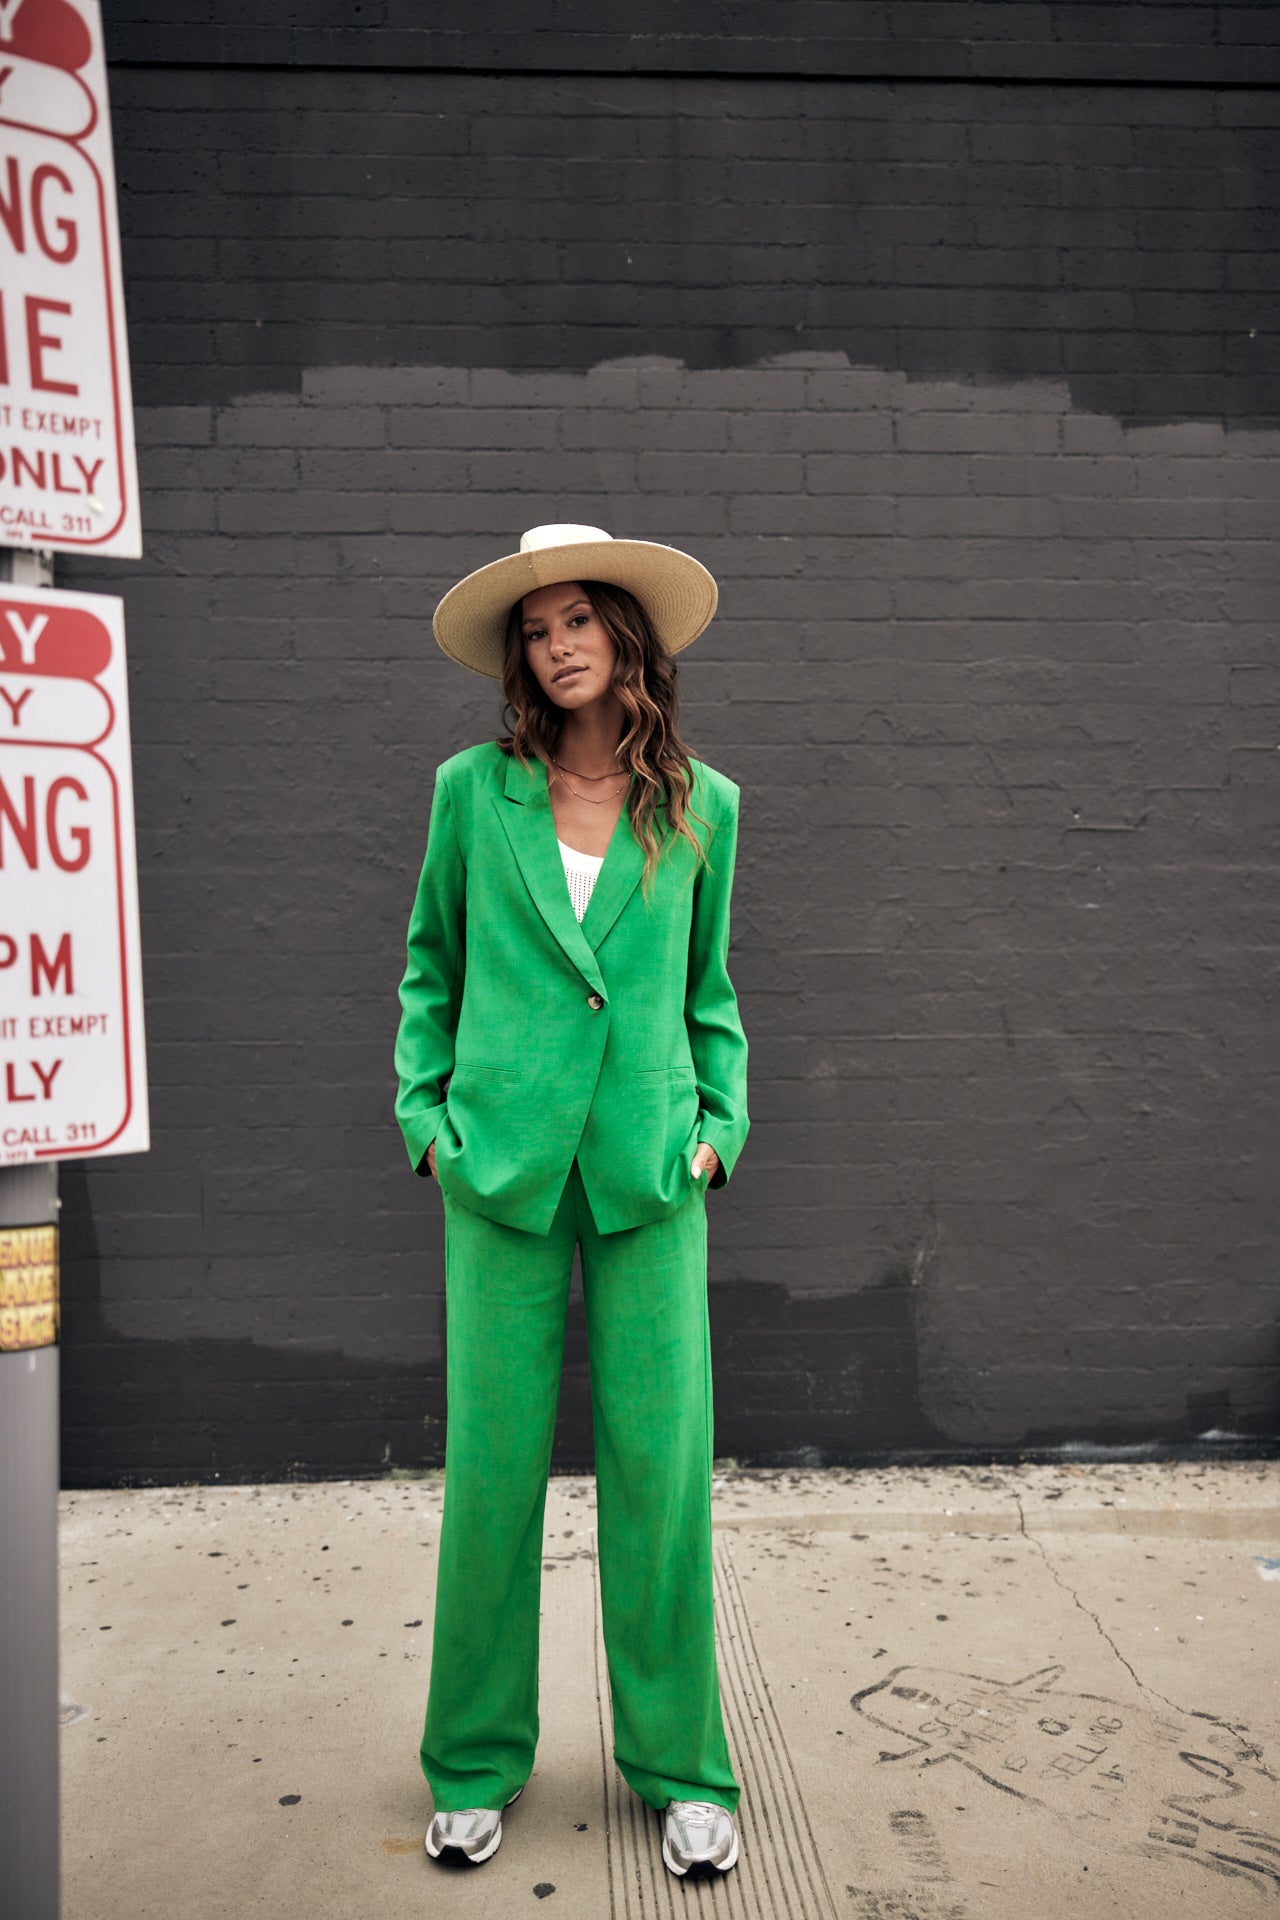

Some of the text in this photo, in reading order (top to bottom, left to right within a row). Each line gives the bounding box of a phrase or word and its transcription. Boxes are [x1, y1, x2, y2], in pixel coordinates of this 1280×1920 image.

[22, 408, 103, 440] EXEMPT
[0, 506, 92, 533] CALL 311
[29, 1014, 108, 1038] EXEMPT
[6, 1059, 63, 1103] LY
[3, 1123, 97, 1147] CALL 311
[1038, 1715, 1123, 1780] SELLING
